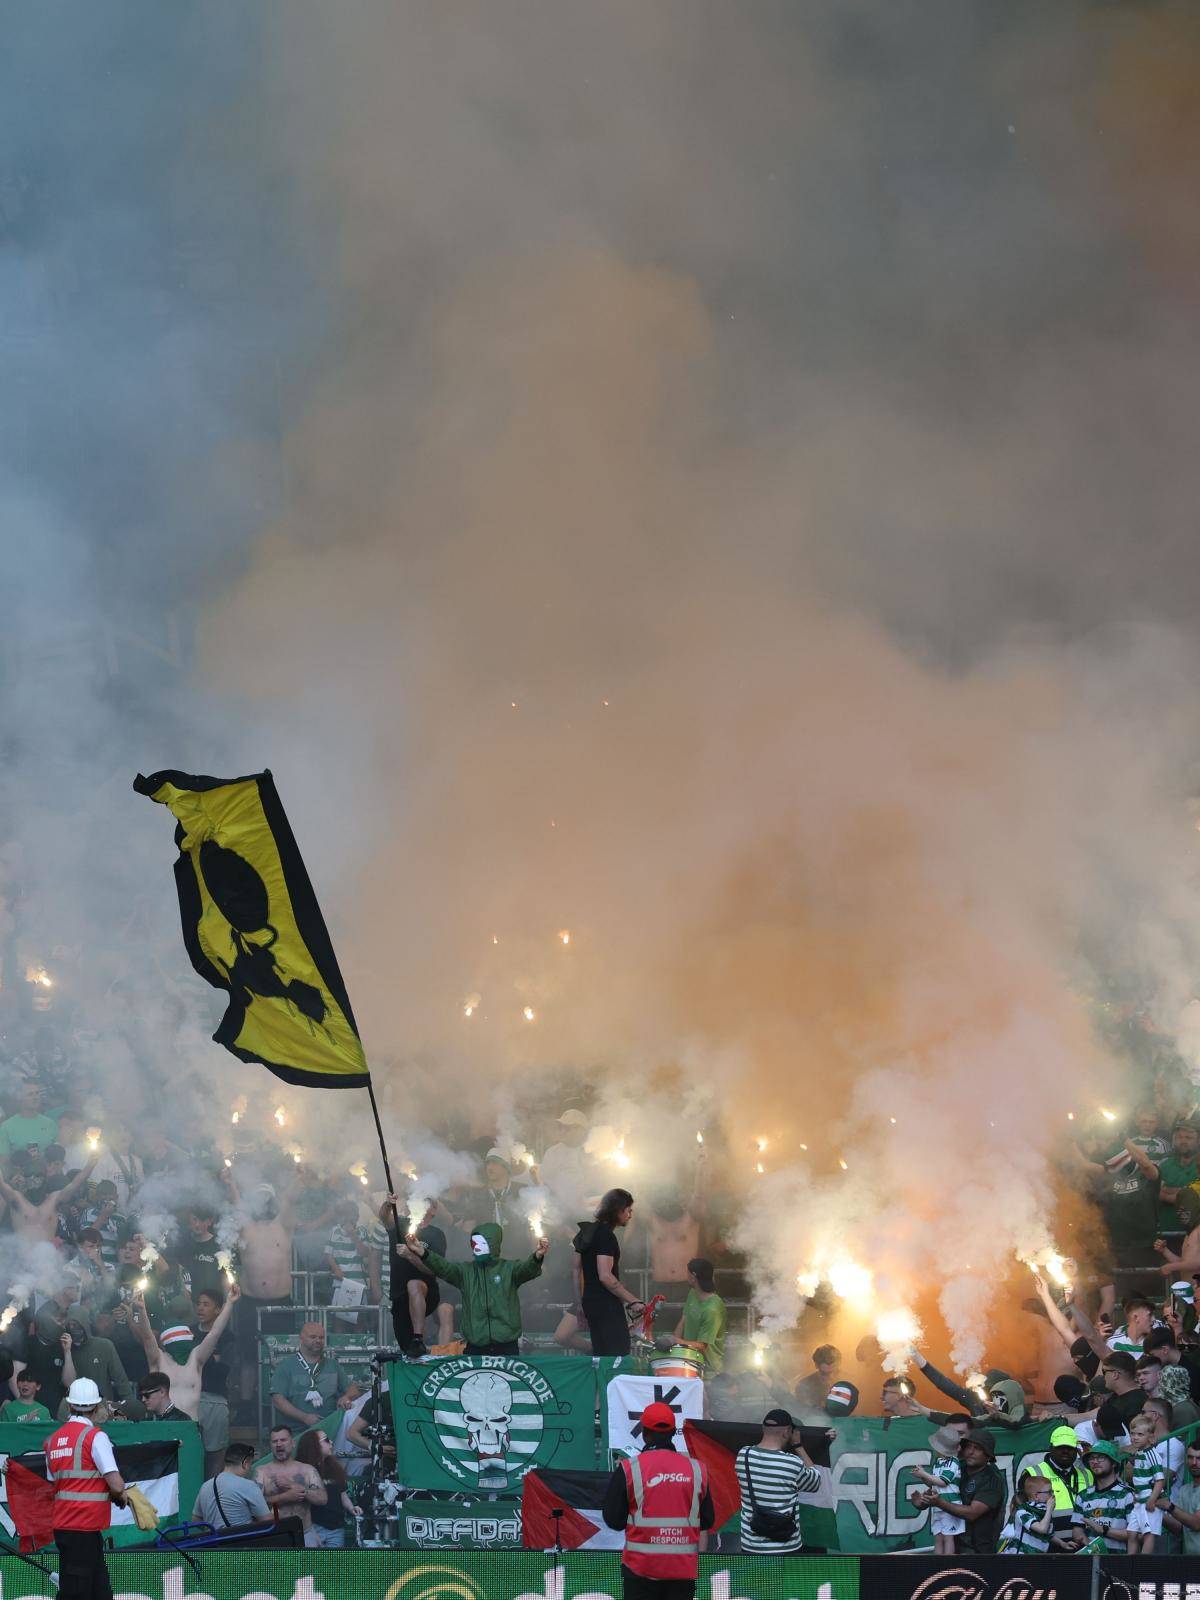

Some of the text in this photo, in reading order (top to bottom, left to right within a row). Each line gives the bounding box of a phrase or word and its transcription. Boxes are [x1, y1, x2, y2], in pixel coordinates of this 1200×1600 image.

[422, 1356, 553, 1403] GREEN BRIGADE
[650, 1536, 690, 1544] RESPONSE
